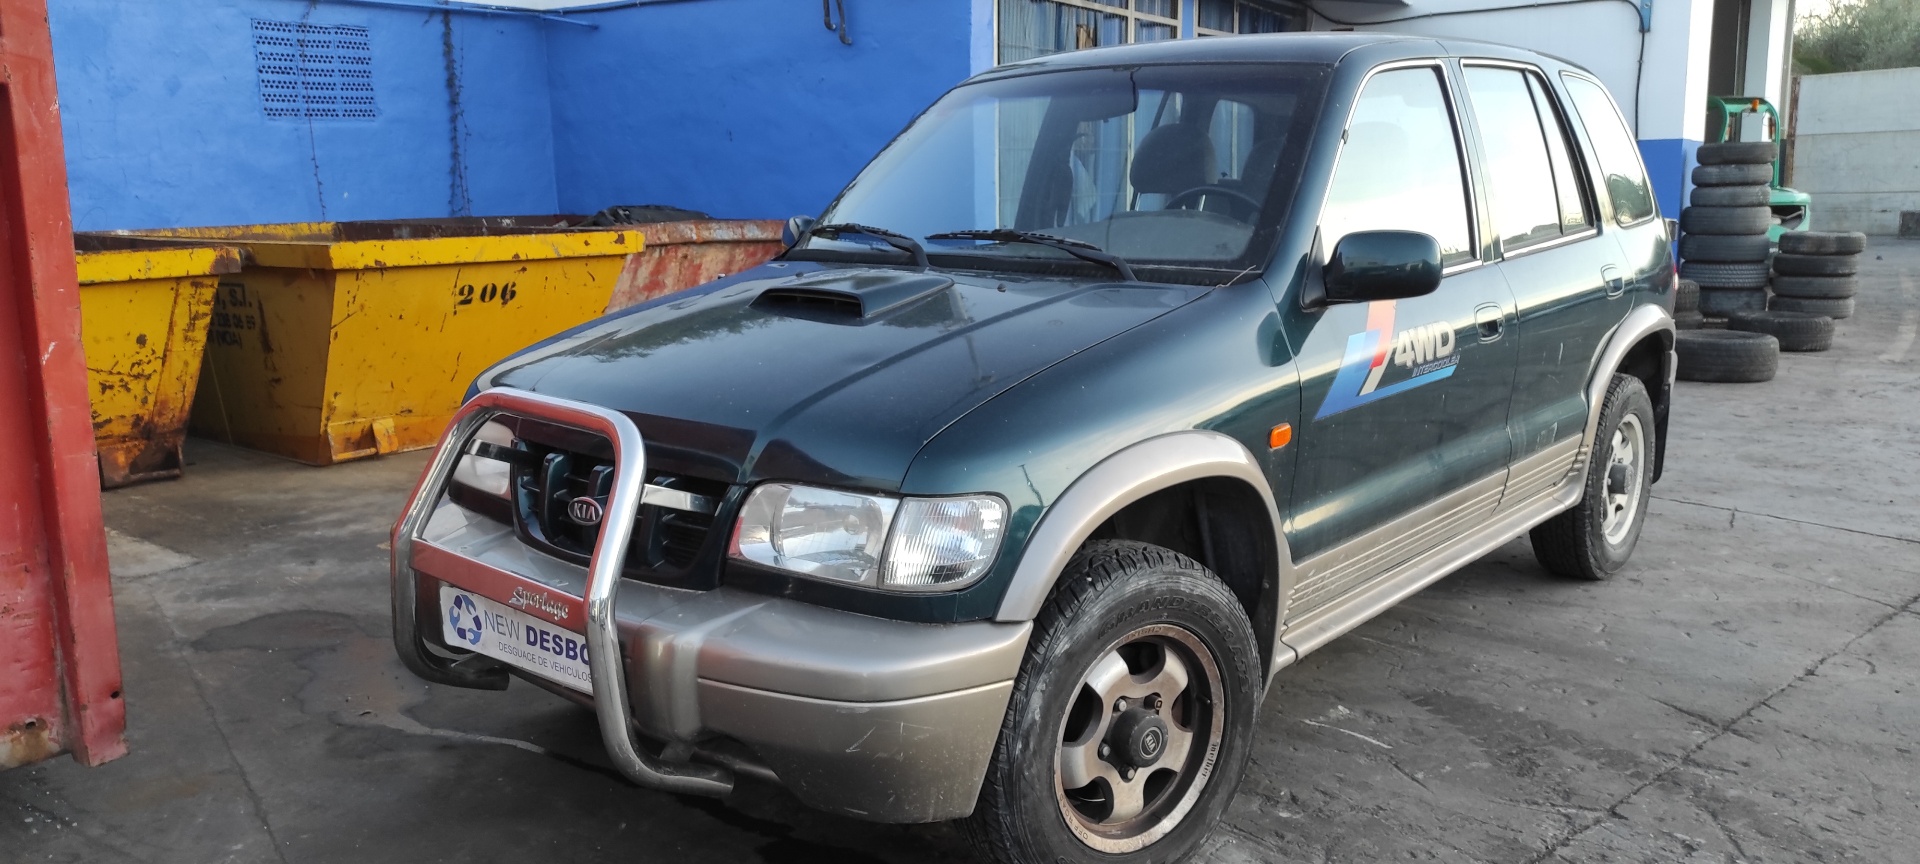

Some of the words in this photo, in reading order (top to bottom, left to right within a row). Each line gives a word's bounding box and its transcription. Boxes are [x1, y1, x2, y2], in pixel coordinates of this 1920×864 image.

[458, 282, 517, 304] 206
[1394, 320, 1456, 369] 4WD
[573, 502, 596, 521] KIA
[508, 586, 569, 621] Sportage
[484, 609, 520, 641] NEW
[498, 641, 537, 664] DESGUACE
[537, 655, 549, 668] DE
[549, 663, 592, 684] VEHICULOS
[1059, 792, 1075, 824] ROAD
[1073, 824, 1089, 841] OFF
